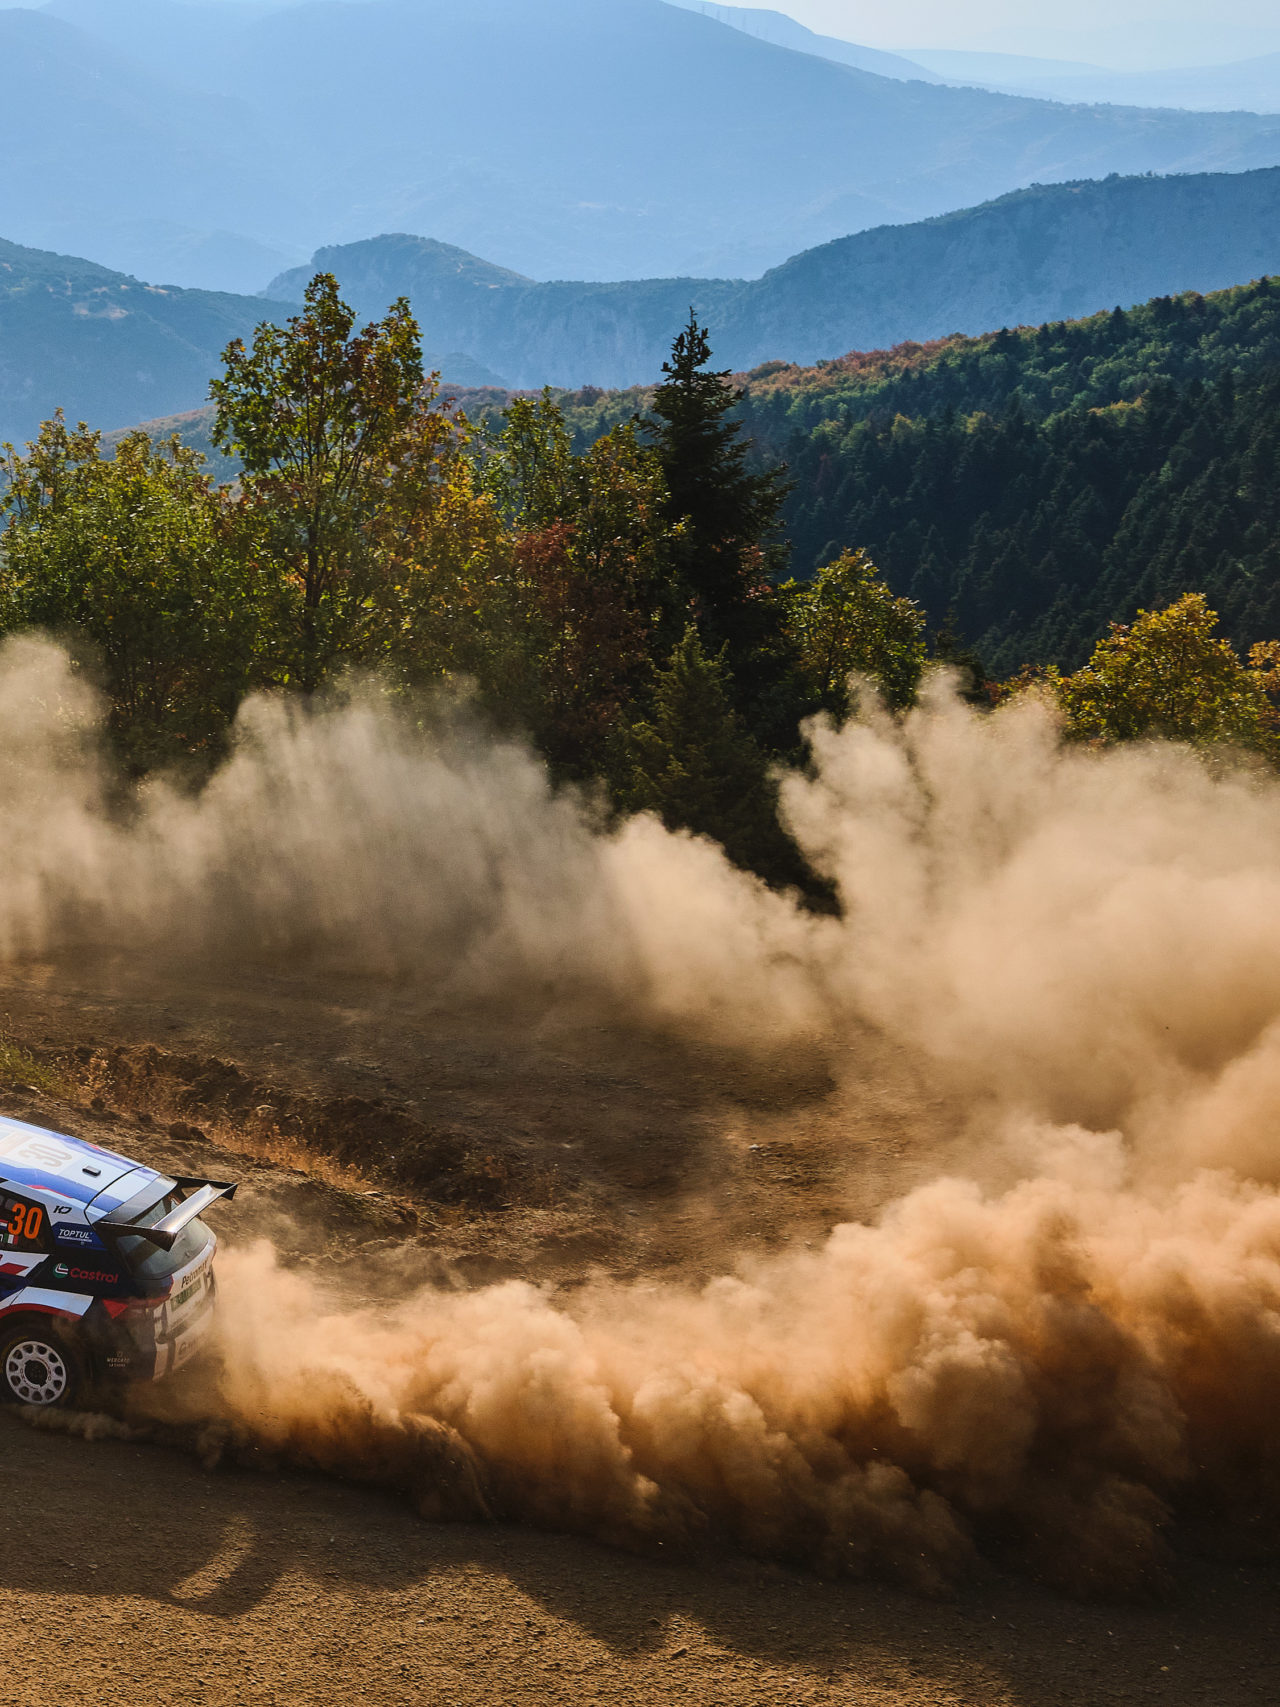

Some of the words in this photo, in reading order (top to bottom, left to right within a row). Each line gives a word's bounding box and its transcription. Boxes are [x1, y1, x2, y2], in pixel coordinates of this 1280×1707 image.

[8, 1203, 43, 1239] 30
[59, 1229, 90, 1239] TOPTUL
[70, 1267, 119, 1283] Castrol
